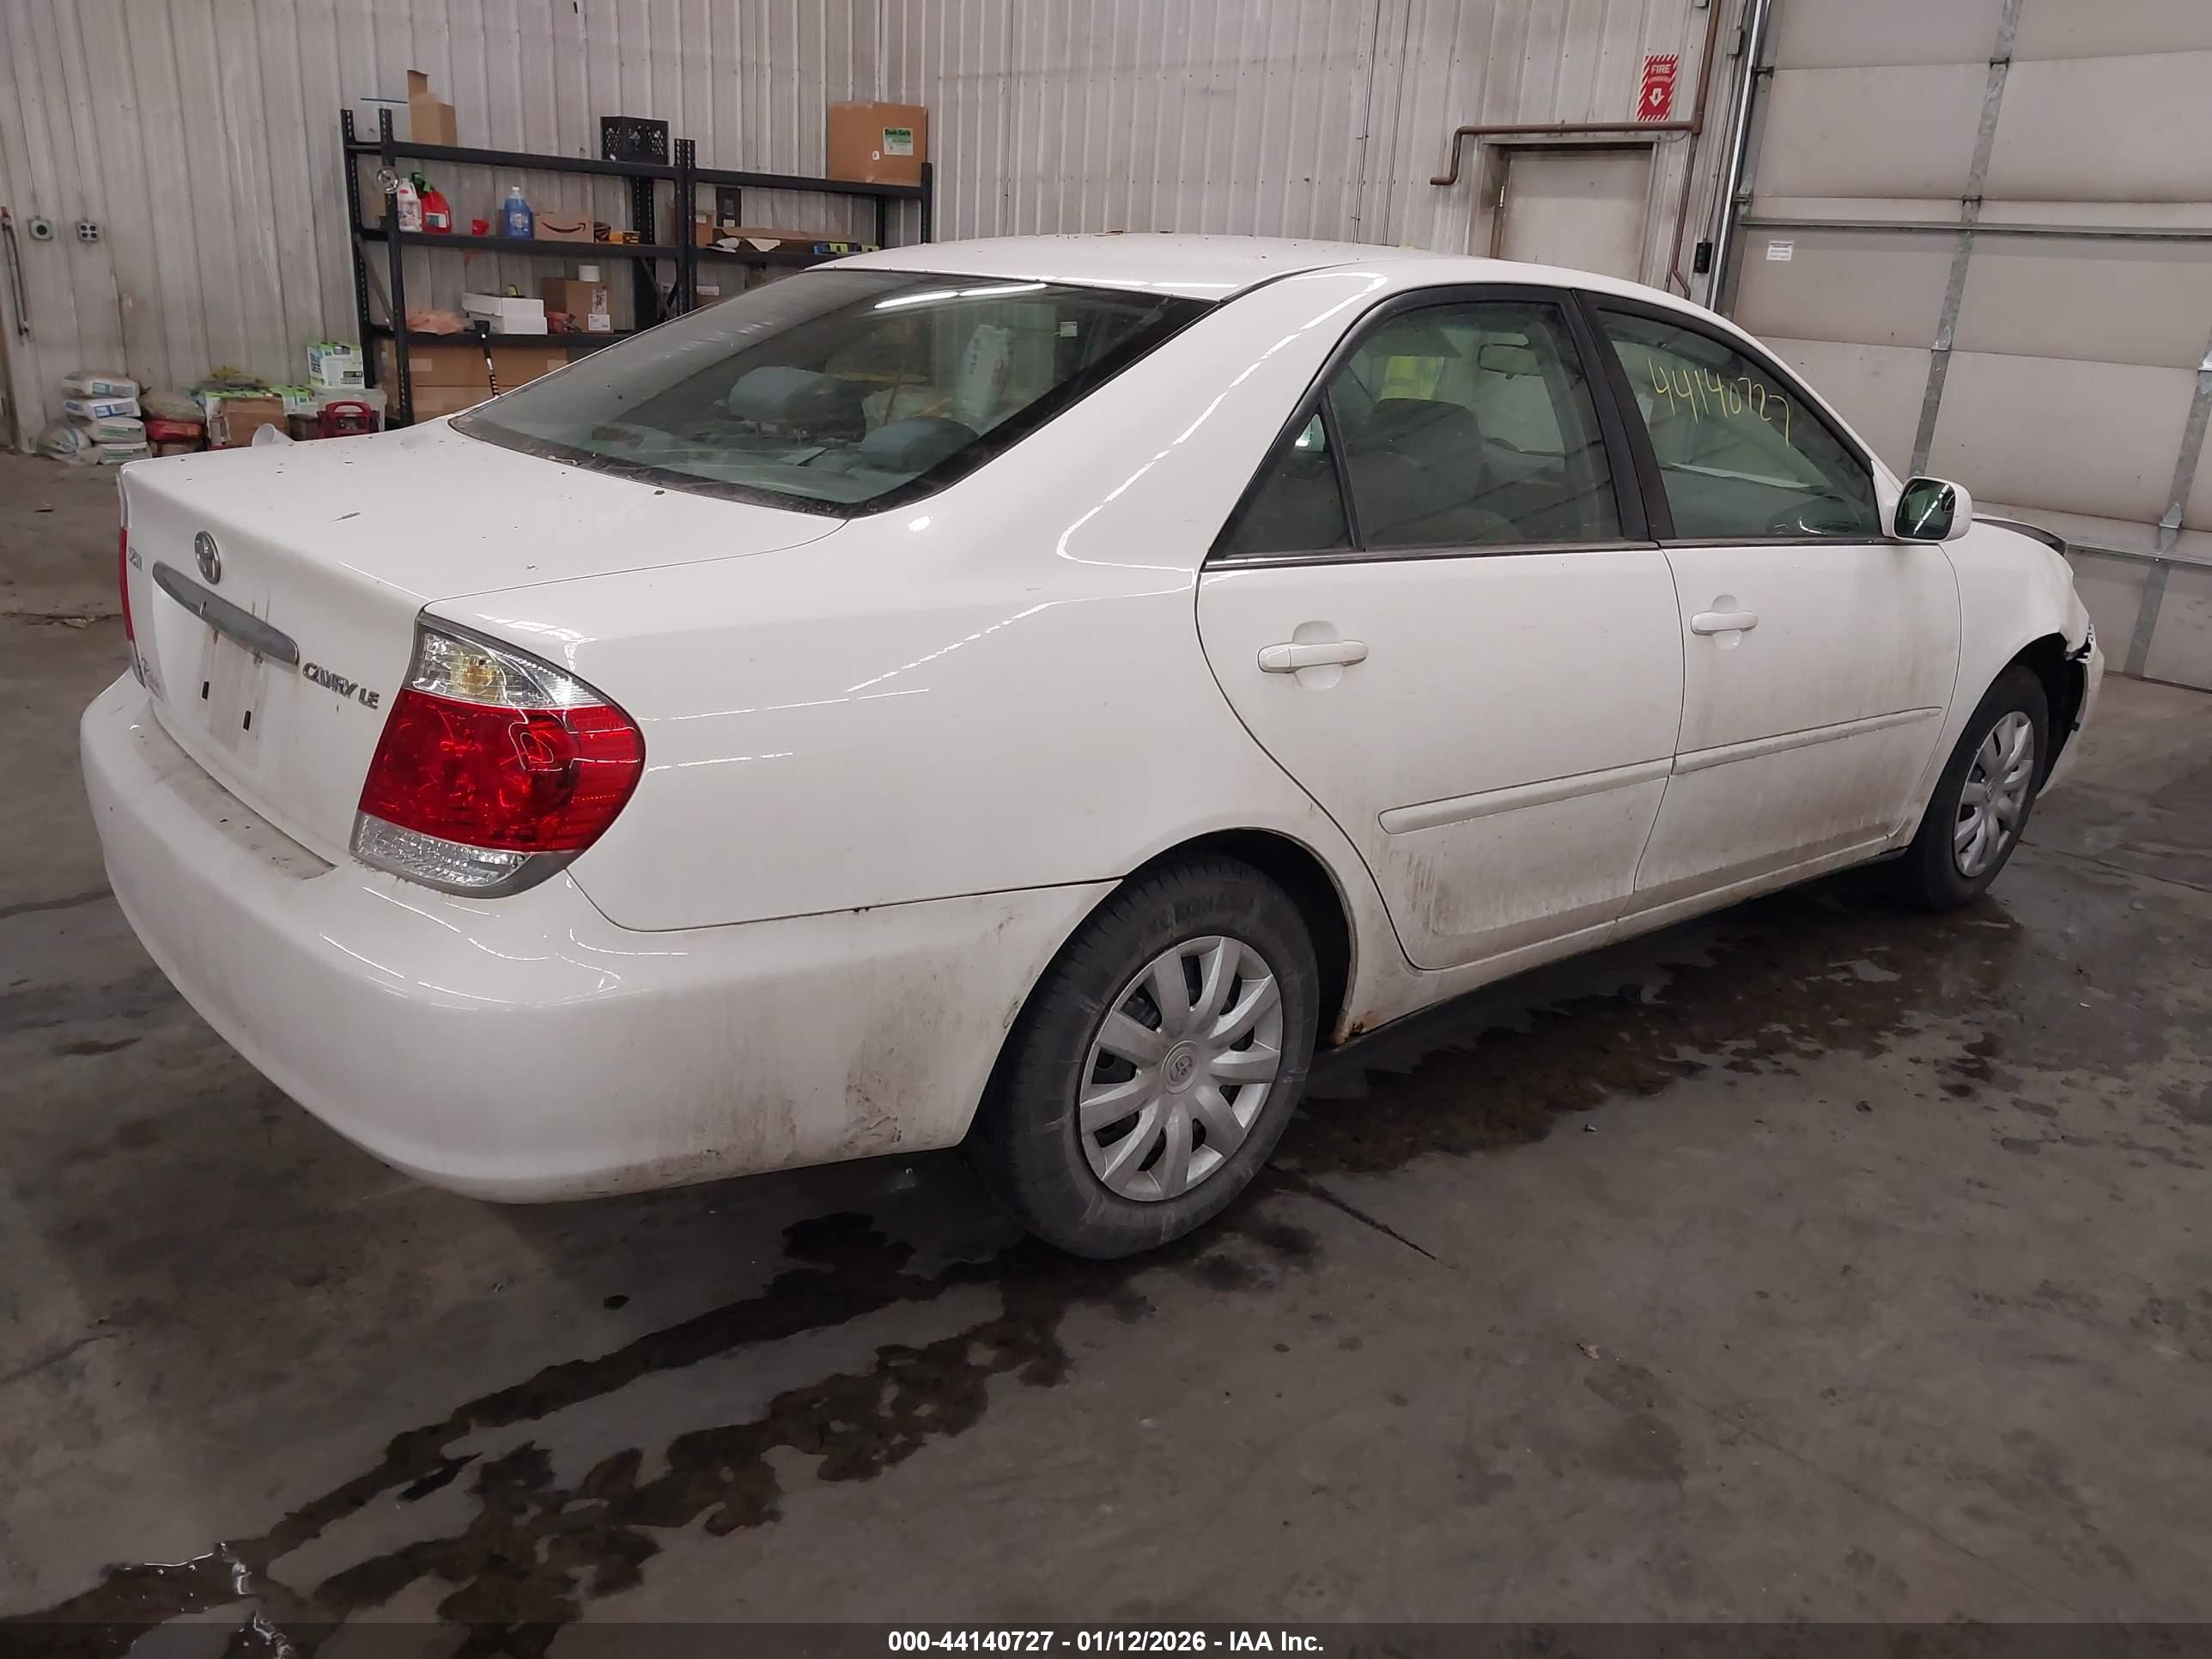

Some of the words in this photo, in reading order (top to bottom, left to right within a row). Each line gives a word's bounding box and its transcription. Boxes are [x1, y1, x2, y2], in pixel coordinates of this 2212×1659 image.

[1650, 64, 1672, 75] FIRE
[1648, 357, 1790, 447] 44140727
[358, 687, 380, 709] LE
